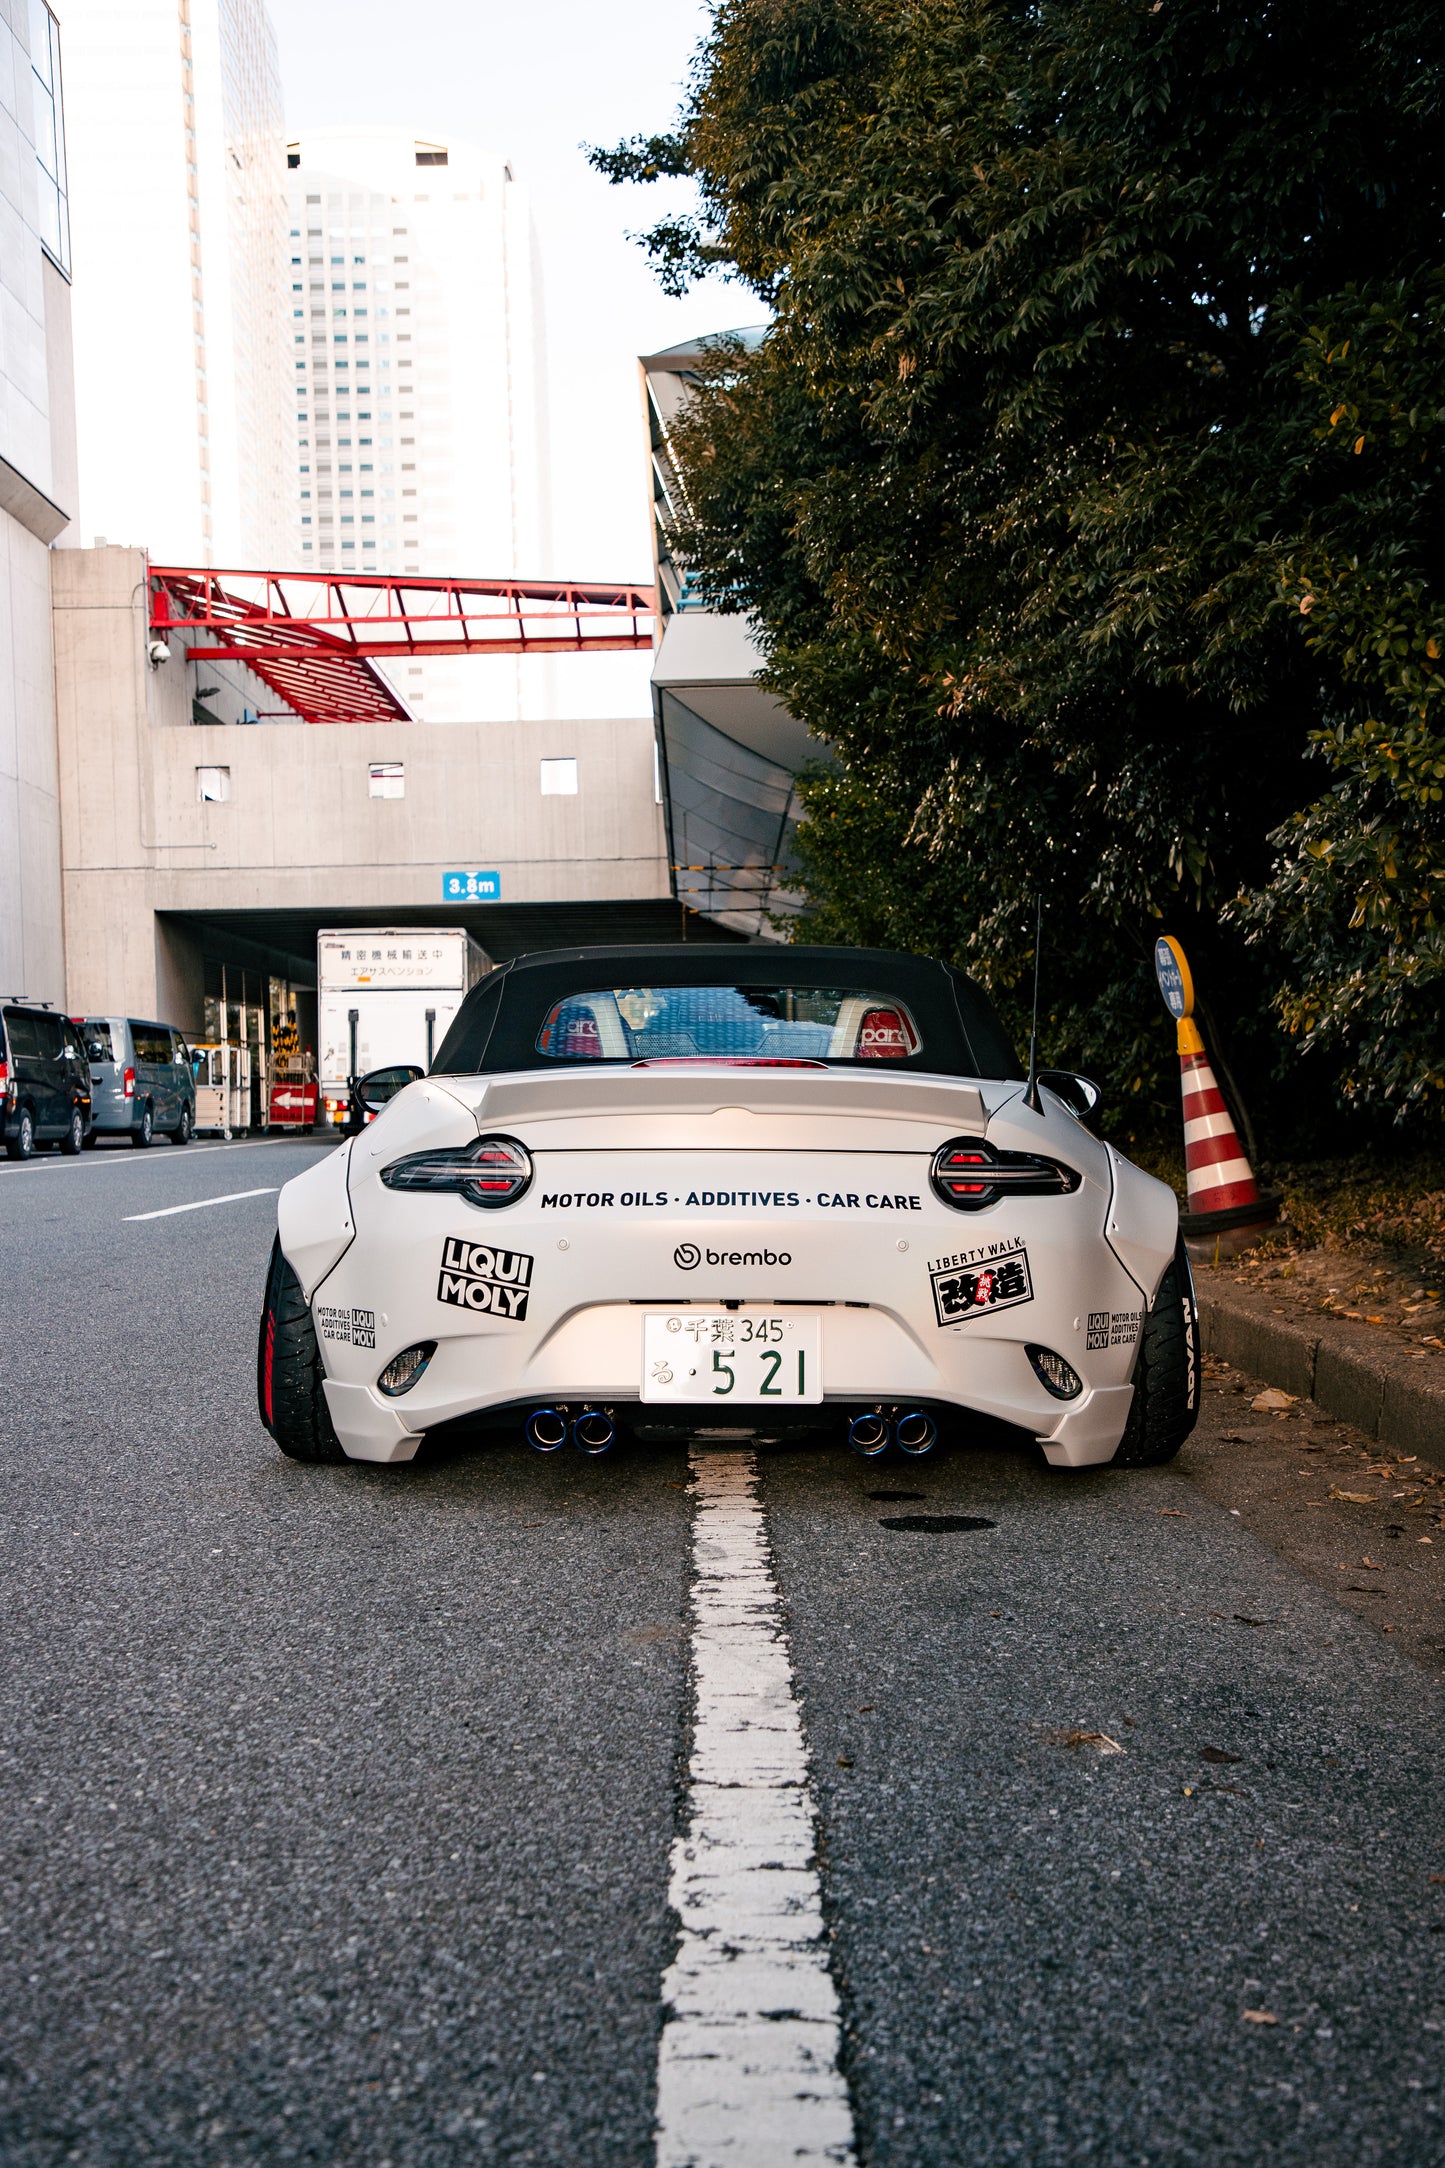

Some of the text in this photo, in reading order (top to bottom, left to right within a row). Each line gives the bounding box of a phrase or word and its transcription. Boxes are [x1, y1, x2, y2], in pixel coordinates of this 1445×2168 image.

[449, 878, 495, 894] 3.8m
[341, 949, 443, 961] 精密機械輸送中
[351, 966, 433, 976] エアサスペンション
[541, 1191, 922, 1211] MOTOR OILS ADDITIVES CAR CARE
[445, 1239, 530, 1285] LIQUI
[705, 1248, 792, 1266] brembo
[927, 1246, 986, 1272] LIBERTY
[440, 1274, 528, 1318] MOLY
[317, 1306, 351, 1320] MOTOR OILS
[352, 1310, 375, 1329] LIQUI
[1111, 1311, 1143, 1323] MOTOR OILS
[321, 1318, 351, 1331] ADDITIVES
[1088, 1313, 1109, 1331] LIQUI
[1111, 1323, 1139, 1334] ADDITIVES
[323, 1329, 351, 1342] CAR CARE
[352, 1331, 375, 1348] MOLY
[740, 1319, 783, 1343] 345
[1110, 1333, 1136, 1345] CAR CARE
[1087, 1333, 1109, 1349] MOLY
[1182, 1297, 1196, 1410] ADVAN
[651, 1361, 674, 1384] る
